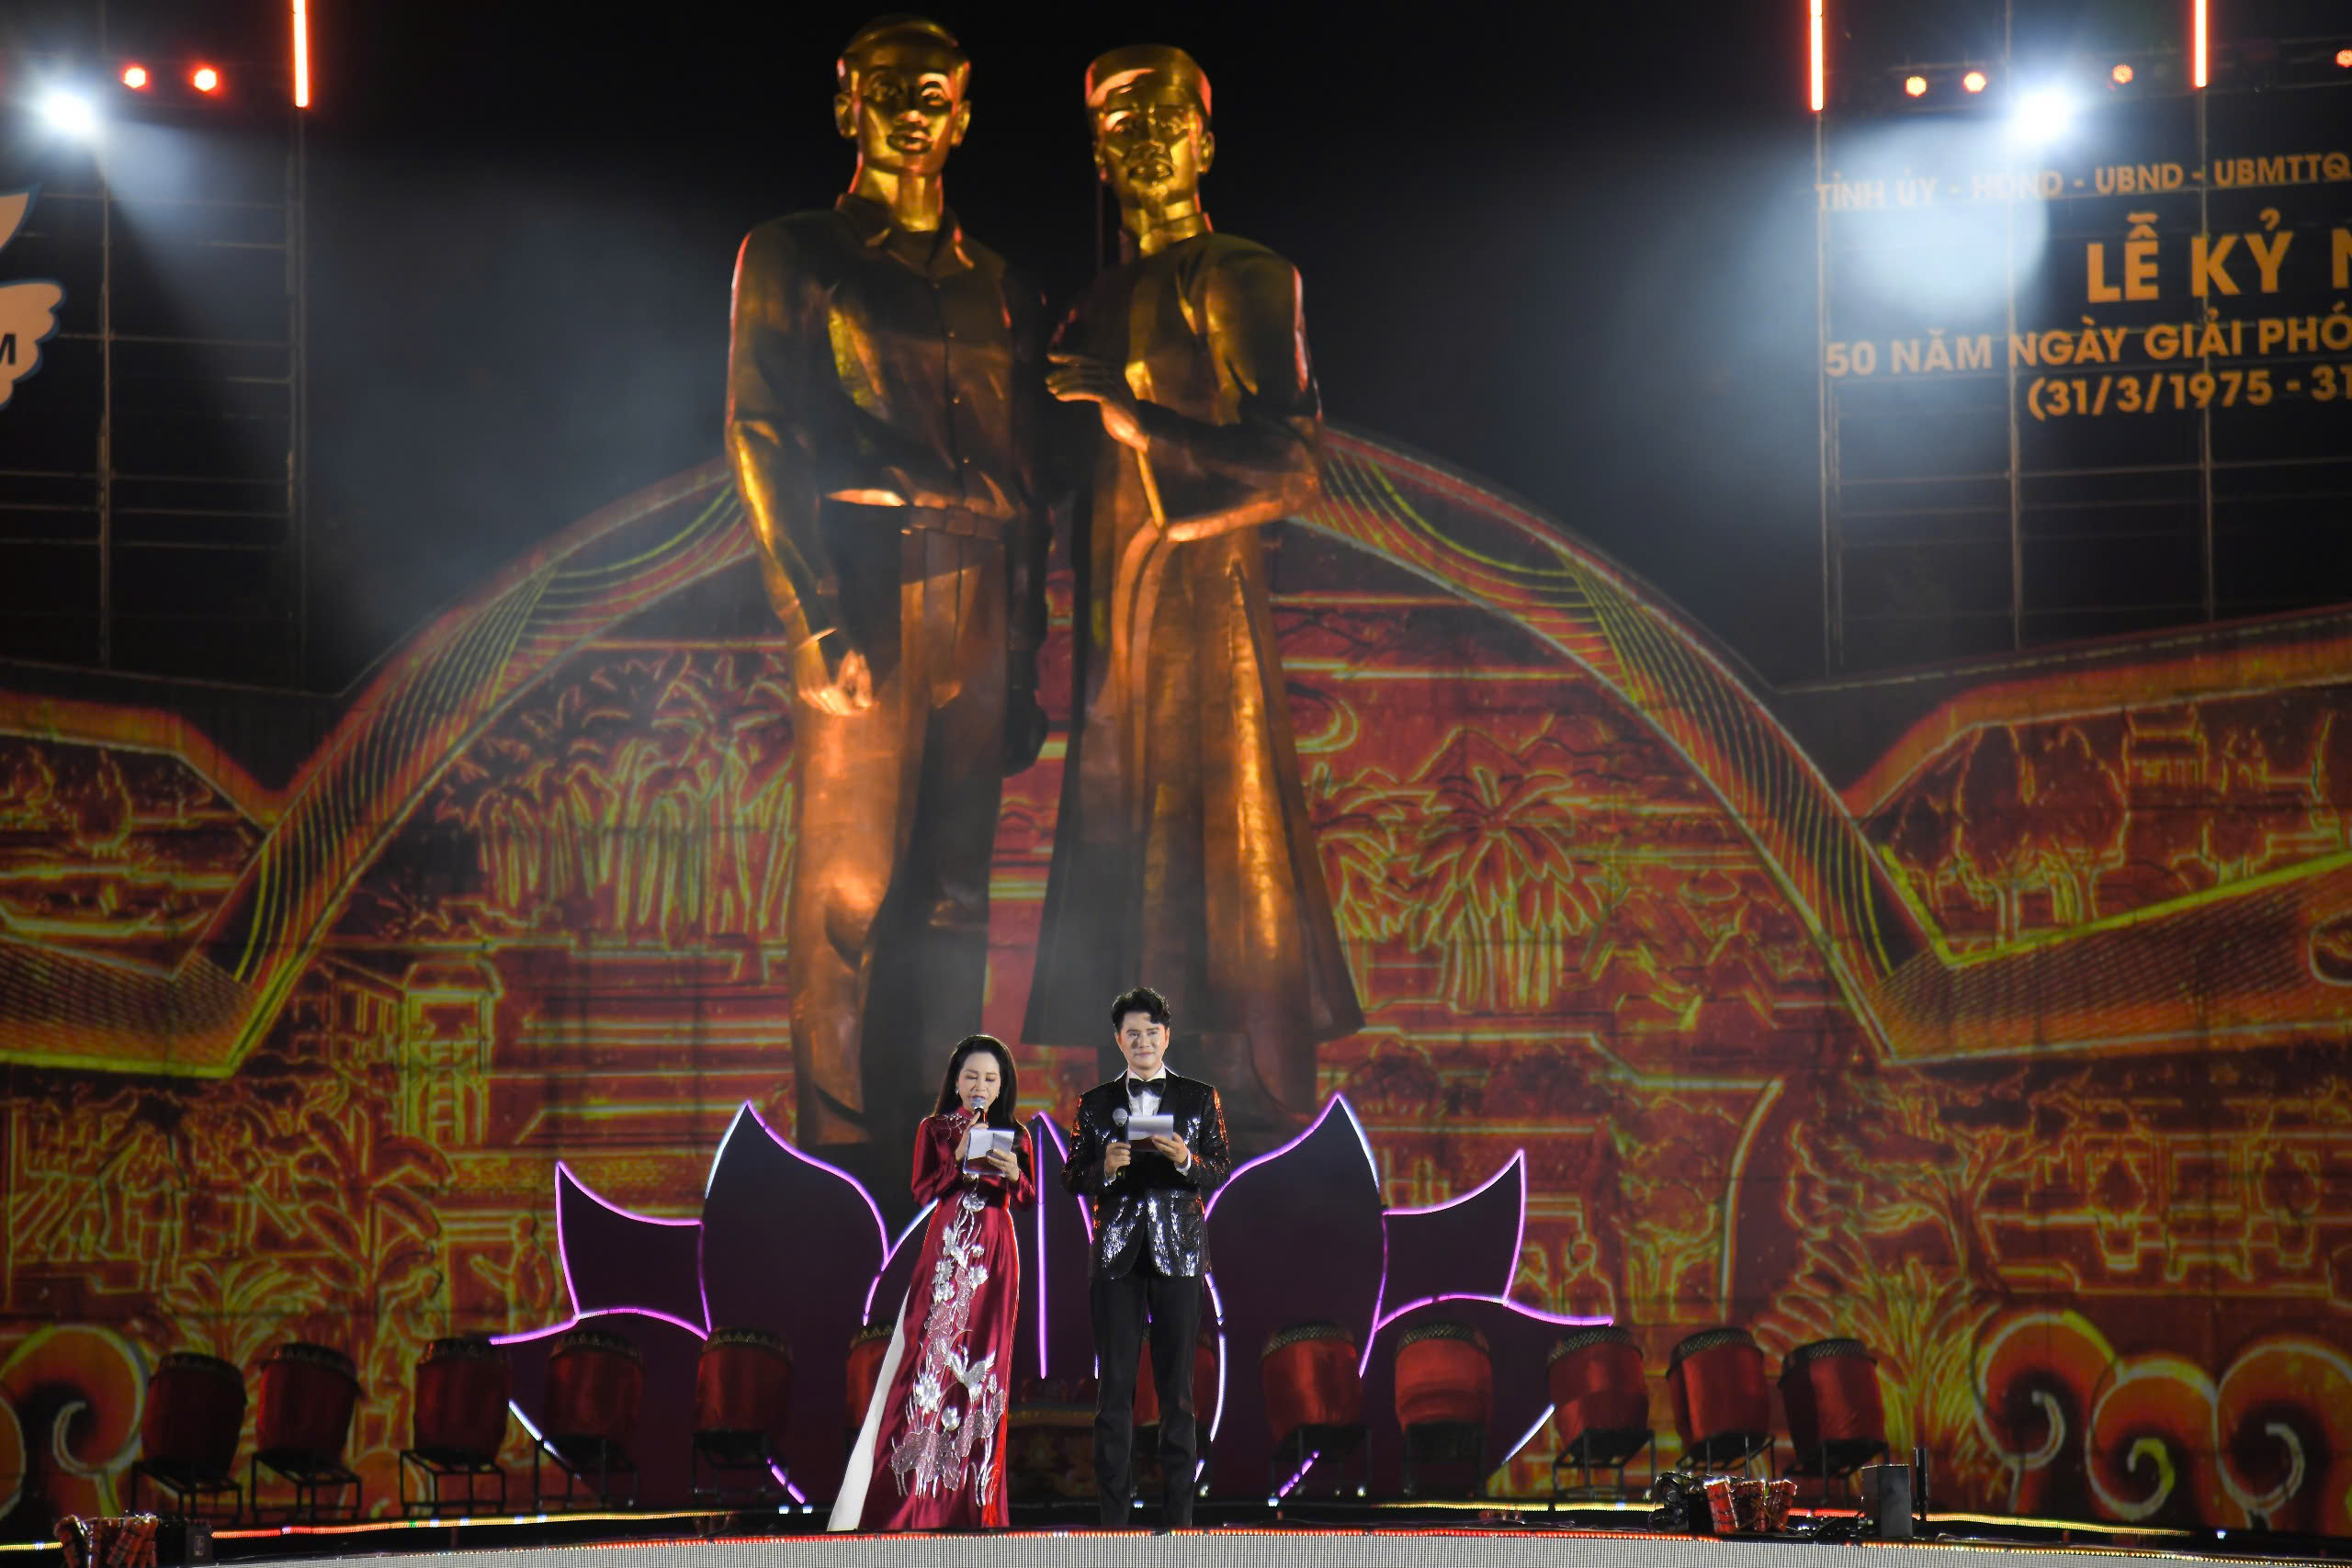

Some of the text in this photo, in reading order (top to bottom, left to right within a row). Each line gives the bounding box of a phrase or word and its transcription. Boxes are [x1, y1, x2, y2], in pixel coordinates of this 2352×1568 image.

[2095, 163, 2184, 194] UBND
[2214, 152, 2352, 187] UBMTTQ
[2087, 212, 2158, 303] LỄ
[2191, 208, 2294, 298] KỶ
[1826, 340, 1876, 378] 50
[1890, 327, 1993, 375] NĂM
[2007, 315, 2129, 367] NGÀY
[2143, 307, 2242, 360] GIẢI
[2028, 369, 2273, 423] (31/3/1975
